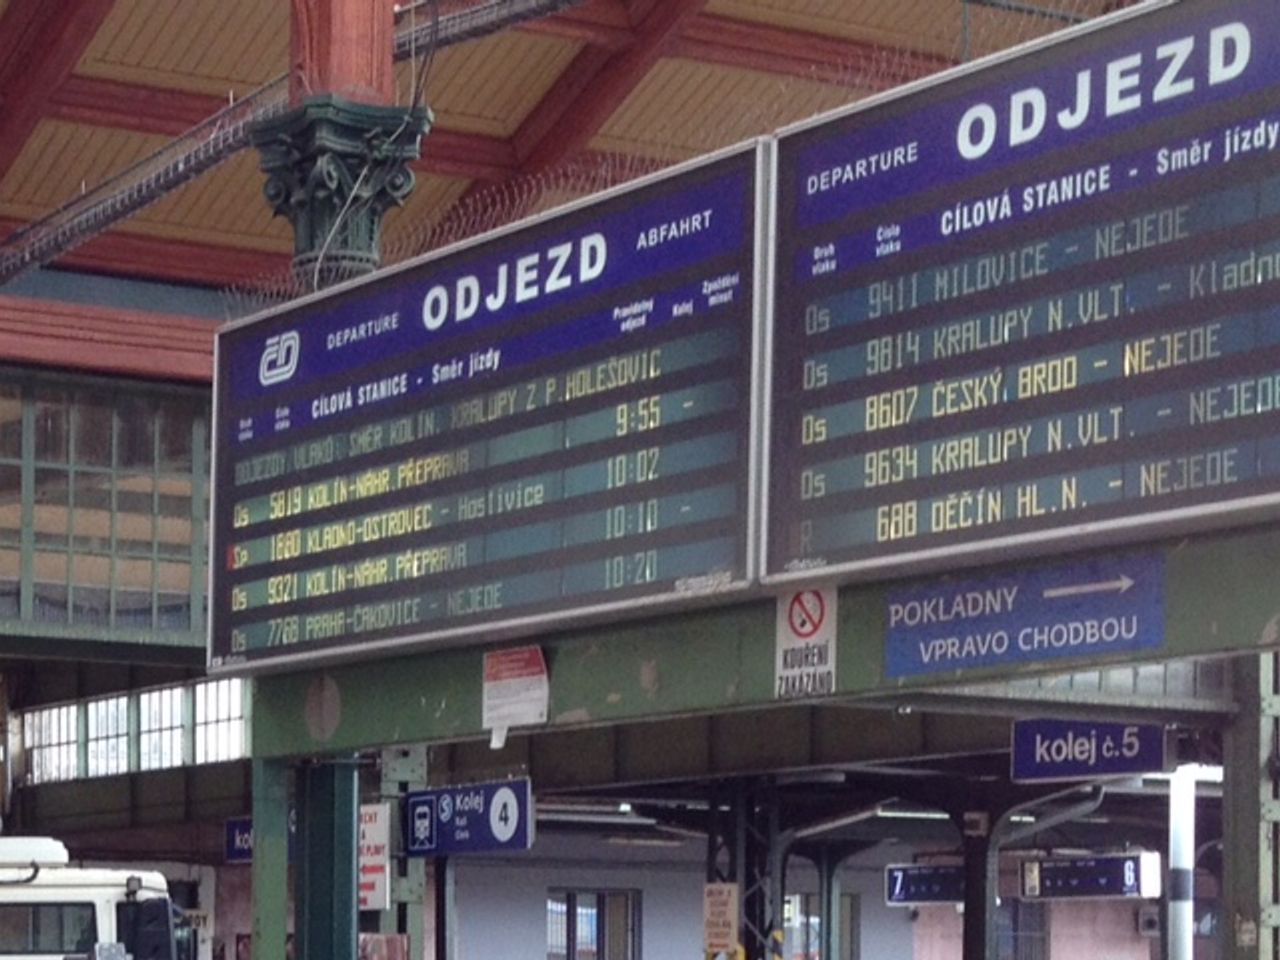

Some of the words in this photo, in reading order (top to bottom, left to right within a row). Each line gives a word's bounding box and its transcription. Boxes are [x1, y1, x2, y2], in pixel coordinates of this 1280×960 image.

[807, 141, 919, 195] DEPARTURE
[956, 21, 1252, 160] ODJEZD
[941, 190, 1013, 236] CÍLOVÁ
[1023, 165, 1111, 213] STANICE
[1156, 138, 1212, 176] Směr
[636, 210, 713, 250] ABFAHRT
[422, 232, 608, 330] ODJEZD
[804, 304, 831, 336] Os
[867, 274, 919, 319] 9411
[934, 243, 1050, 301] MILOVICE
[326, 312, 400, 350] DEPARTURE
[803, 359, 829, 391] Os
[865, 332, 920, 377] 9814
[933, 306, 1032, 359] KRALUPY
[312, 387, 353, 419] CÍLOVÁ
[357, 374, 408, 407] STANICE
[616, 396, 661, 437] 9:55
[801, 414, 827, 446] Os
[865, 387, 919, 432] 8607
[931, 370, 1004, 418] ČESKÝ
[606, 449, 660, 489] 10:02
[800, 469, 826, 500] Os
[864, 448, 918, 489] 9634
[931, 425, 1032, 476] KRALUPY
[604, 550, 658, 590] 10:20
[889, 585, 1019, 630] POKLADNY
[919, 630, 1009, 665] VPRAVO
[1017, 615, 1139, 653] CHODBOU
[1035, 729, 1097, 766] kolej
[455, 789, 485, 814] Kolej
[497, 801, 510, 828] 4
[892, 869, 904, 896] 7
[1123, 859, 1135, 887] 6
